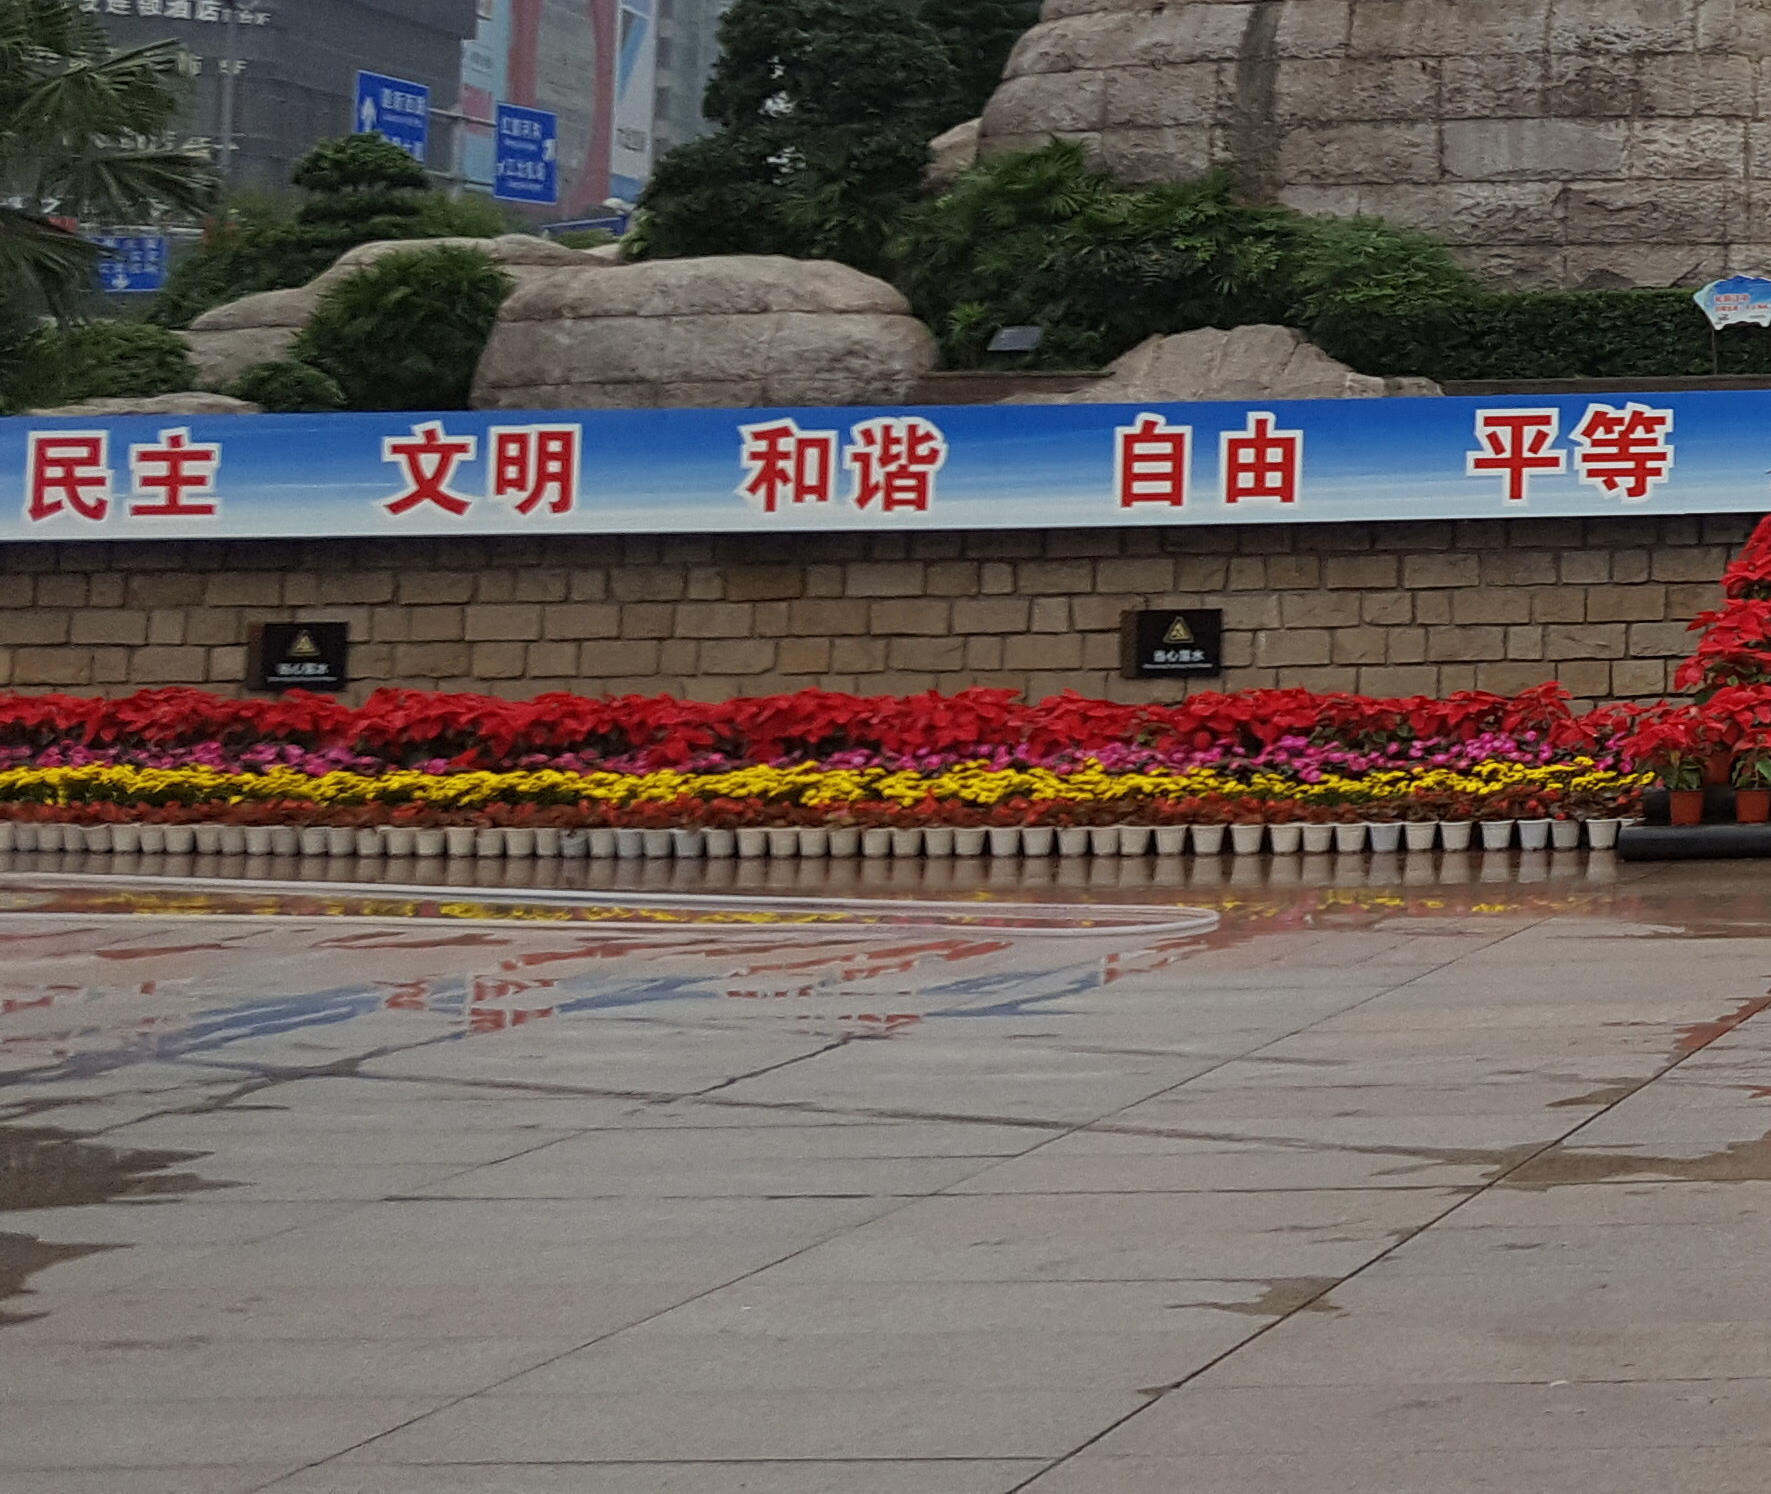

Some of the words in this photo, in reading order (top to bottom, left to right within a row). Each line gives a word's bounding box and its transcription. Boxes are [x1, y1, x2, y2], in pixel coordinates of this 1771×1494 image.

[26, 432, 218, 524] 民主
[386, 425, 578, 518] 文明
[745, 420, 944, 516] 和谐
[1118, 414, 1300, 511] 自由
[1471, 406, 1672, 504] 平等
